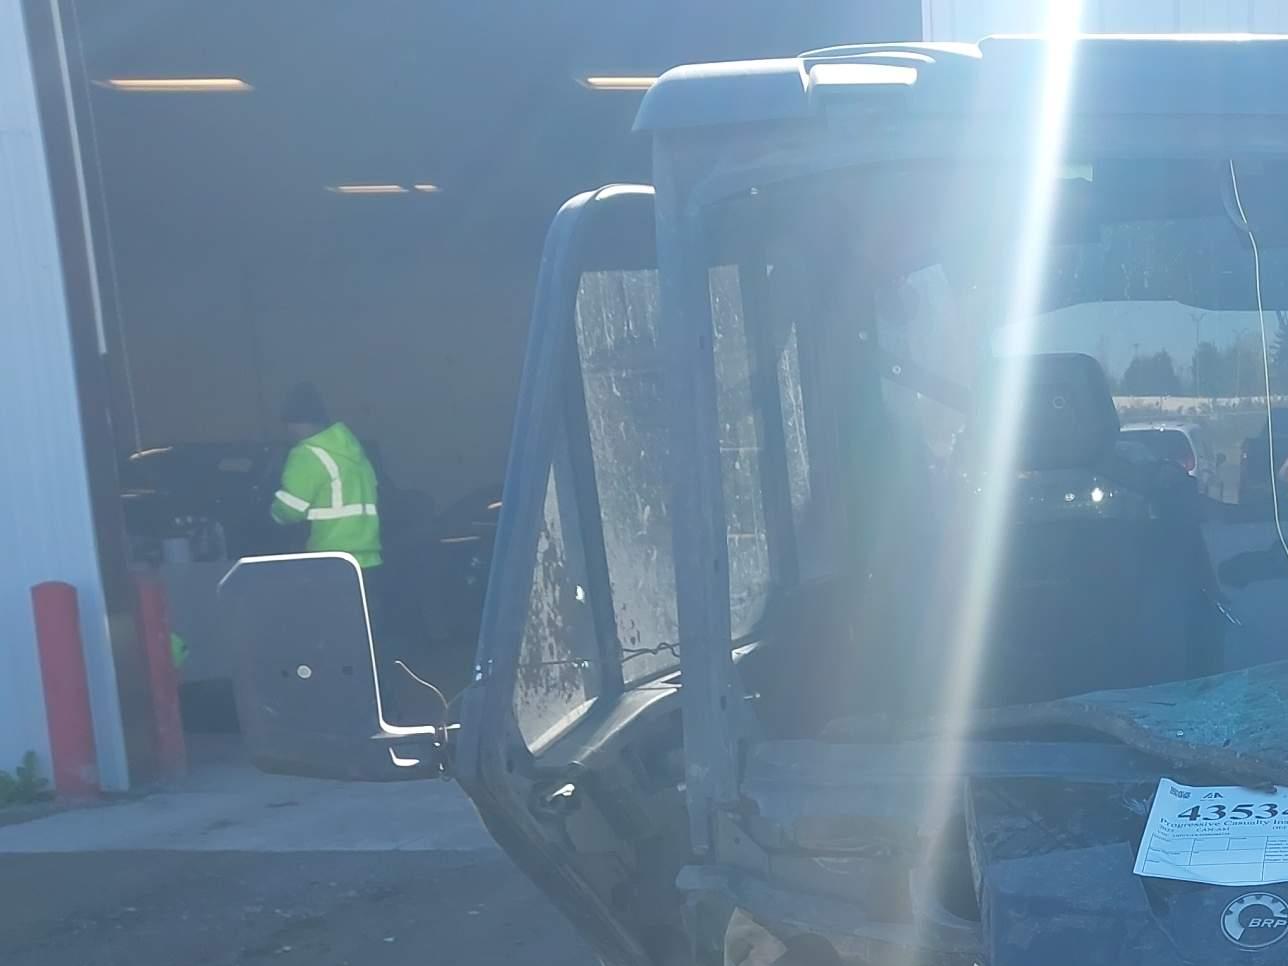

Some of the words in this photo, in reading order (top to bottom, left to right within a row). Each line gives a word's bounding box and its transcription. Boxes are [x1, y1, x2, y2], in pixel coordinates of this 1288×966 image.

[1160, 817, 1221, 828] Progressive
[1223, 819, 1270, 827] Casualty
[1247, 918, 1288, 928] BRP
